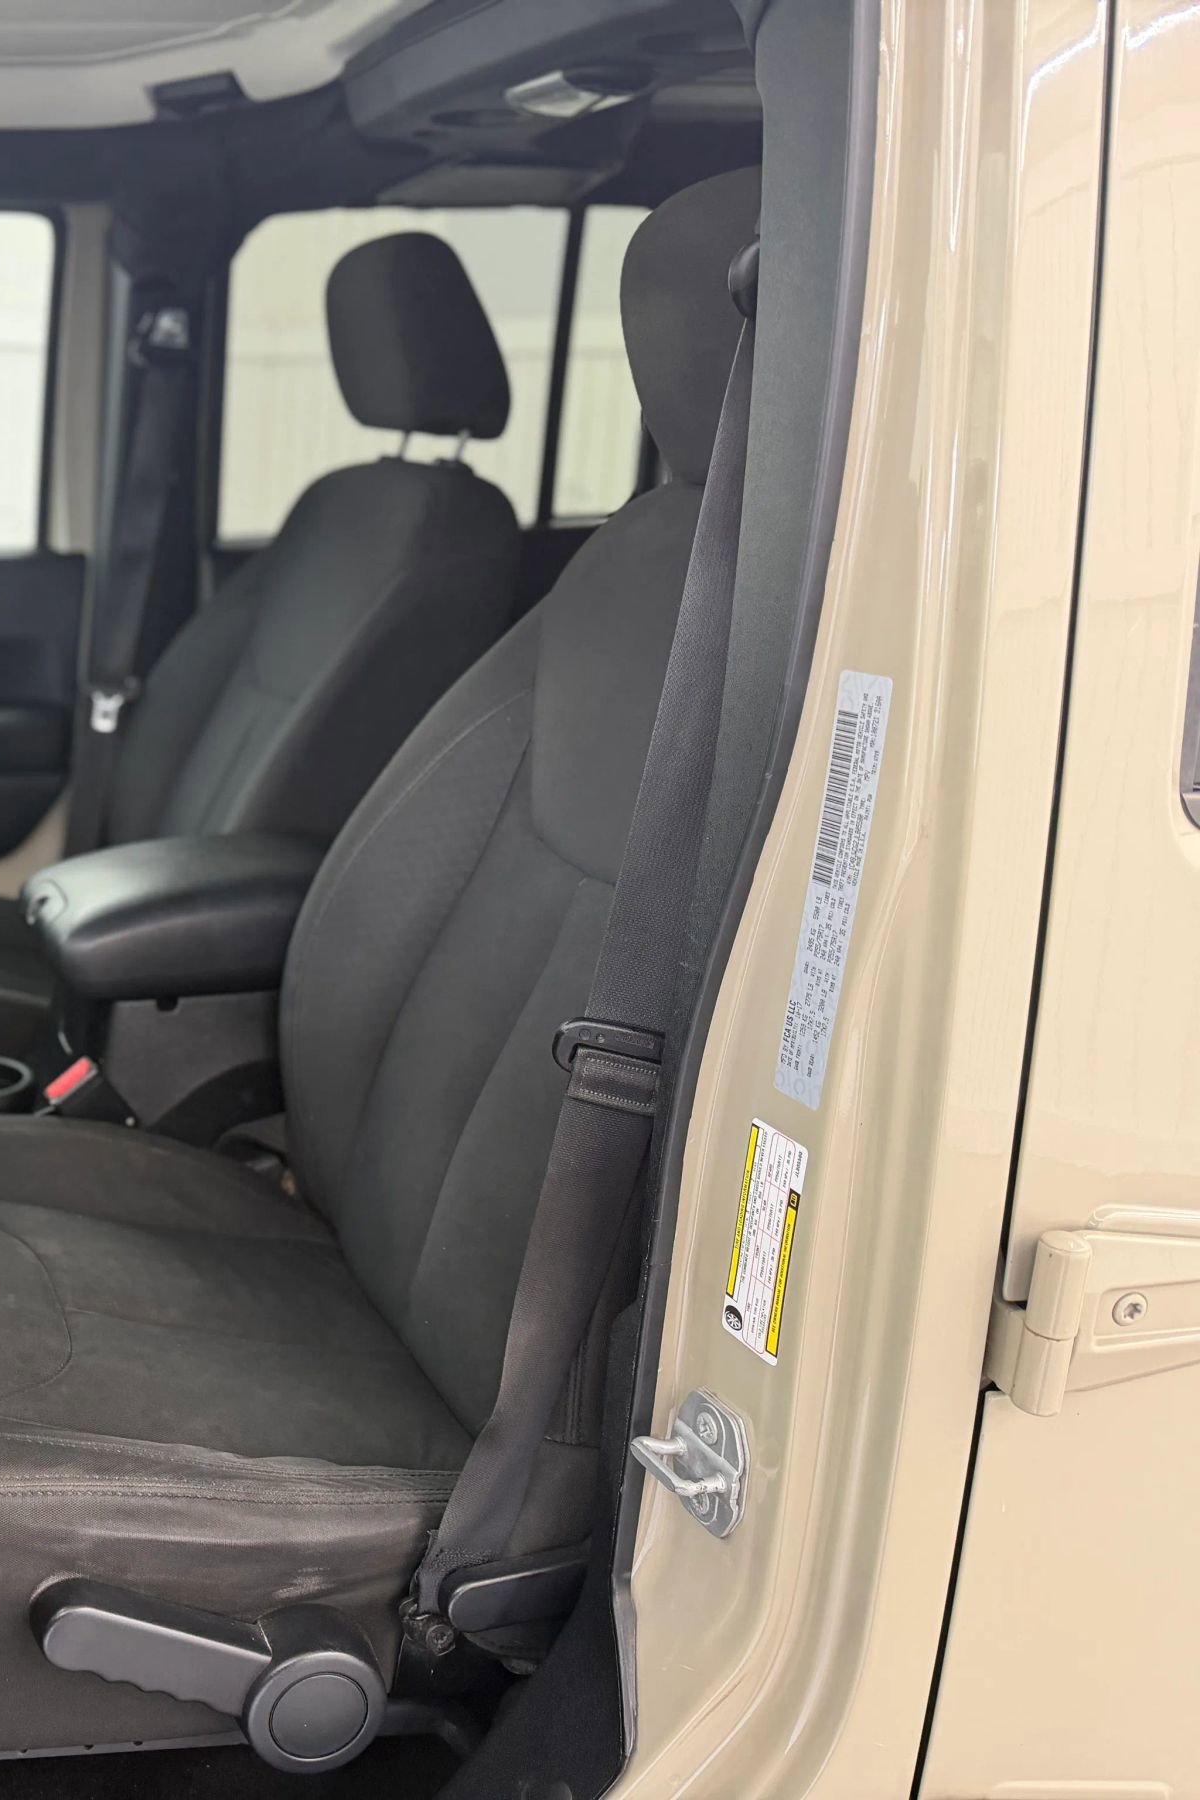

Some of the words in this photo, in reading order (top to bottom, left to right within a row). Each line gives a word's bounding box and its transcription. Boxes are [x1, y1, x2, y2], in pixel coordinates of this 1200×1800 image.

[787, 999, 796, 1014] LLC
[785, 1014, 793, 1026] US
[782, 1026, 791, 1043] FCA
